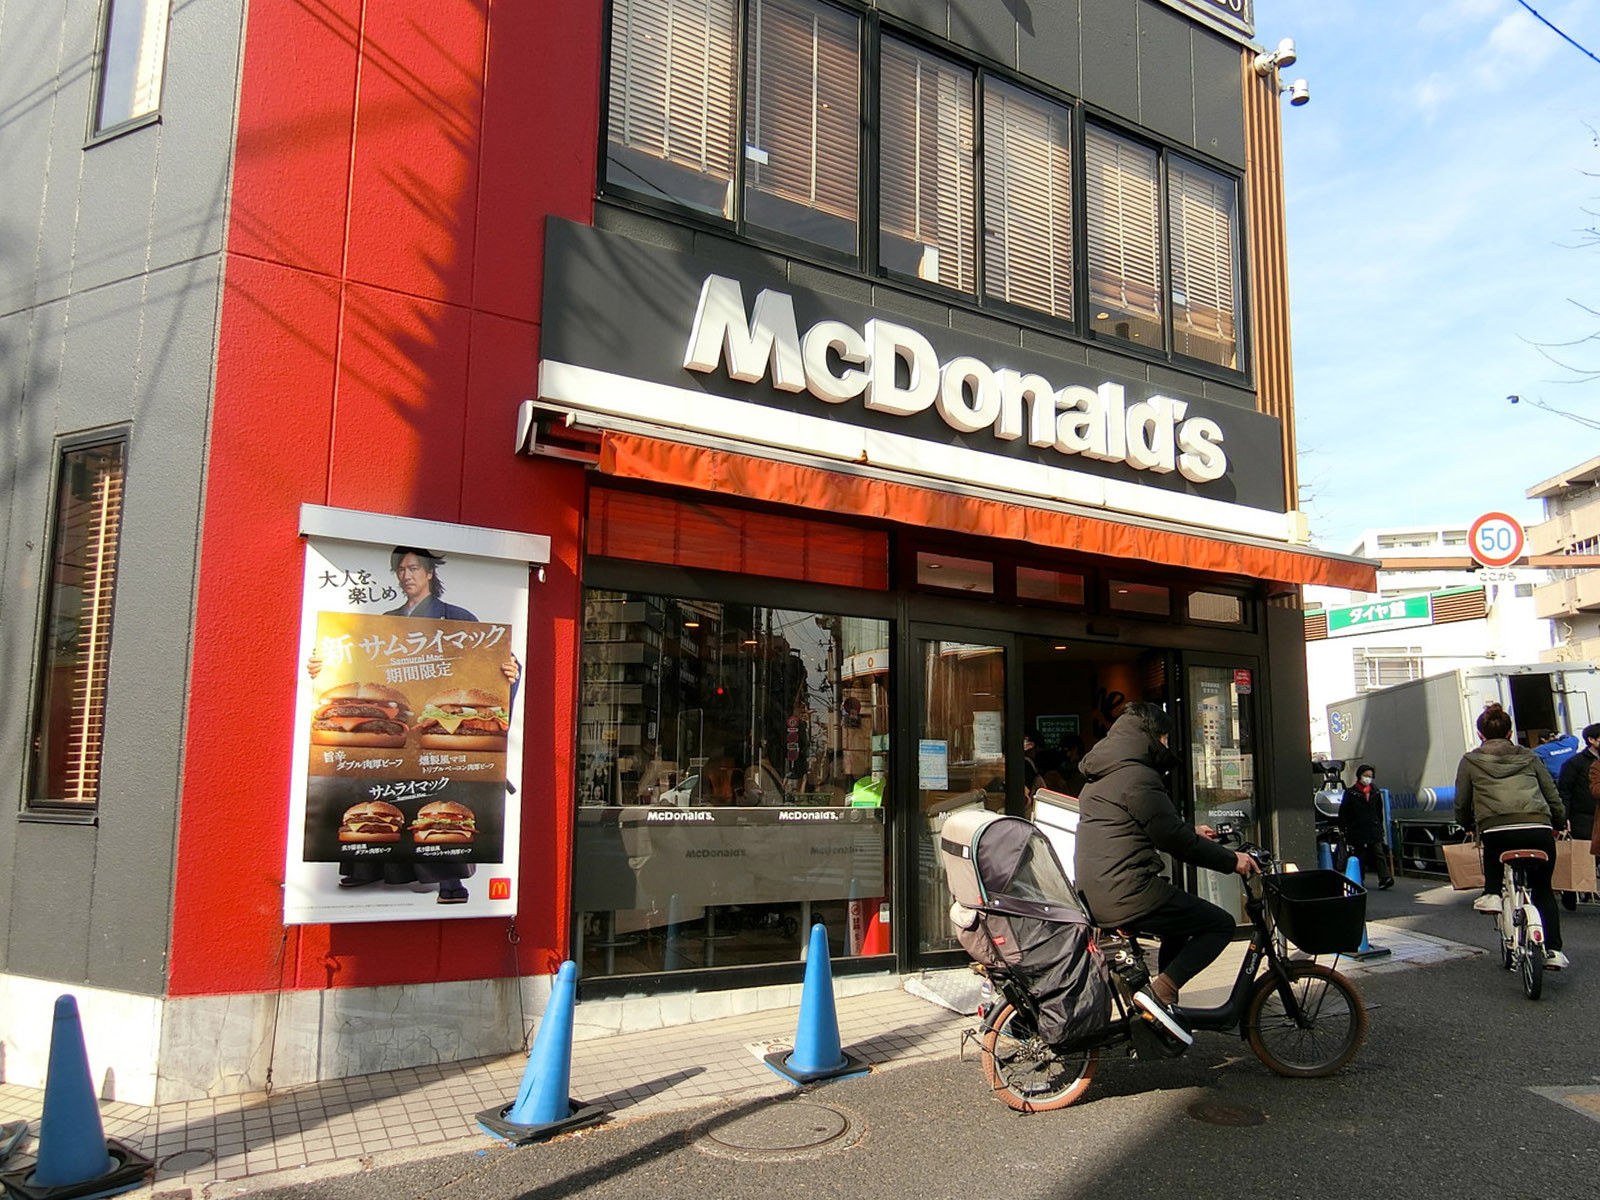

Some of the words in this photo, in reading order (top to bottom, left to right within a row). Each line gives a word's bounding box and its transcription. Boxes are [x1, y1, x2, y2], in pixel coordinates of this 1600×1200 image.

[683, 273, 1227, 483] McDonald's
[1481, 528, 1511, 551] 50
[319, 570, 377, 589] 大人を、
[1479, 572, 1517, 582] ここから
[348, 585, 398, 605] 楽しめ
[358, 624, 507, 662] サムライマック
[386, 662, 454, 684] 期間限定
[324, 751, 346, 763] 旨辛
[336, 759, 404, 771] ダブル肉厚ビーフ
[368, 776, 450, 800] サムライマック
